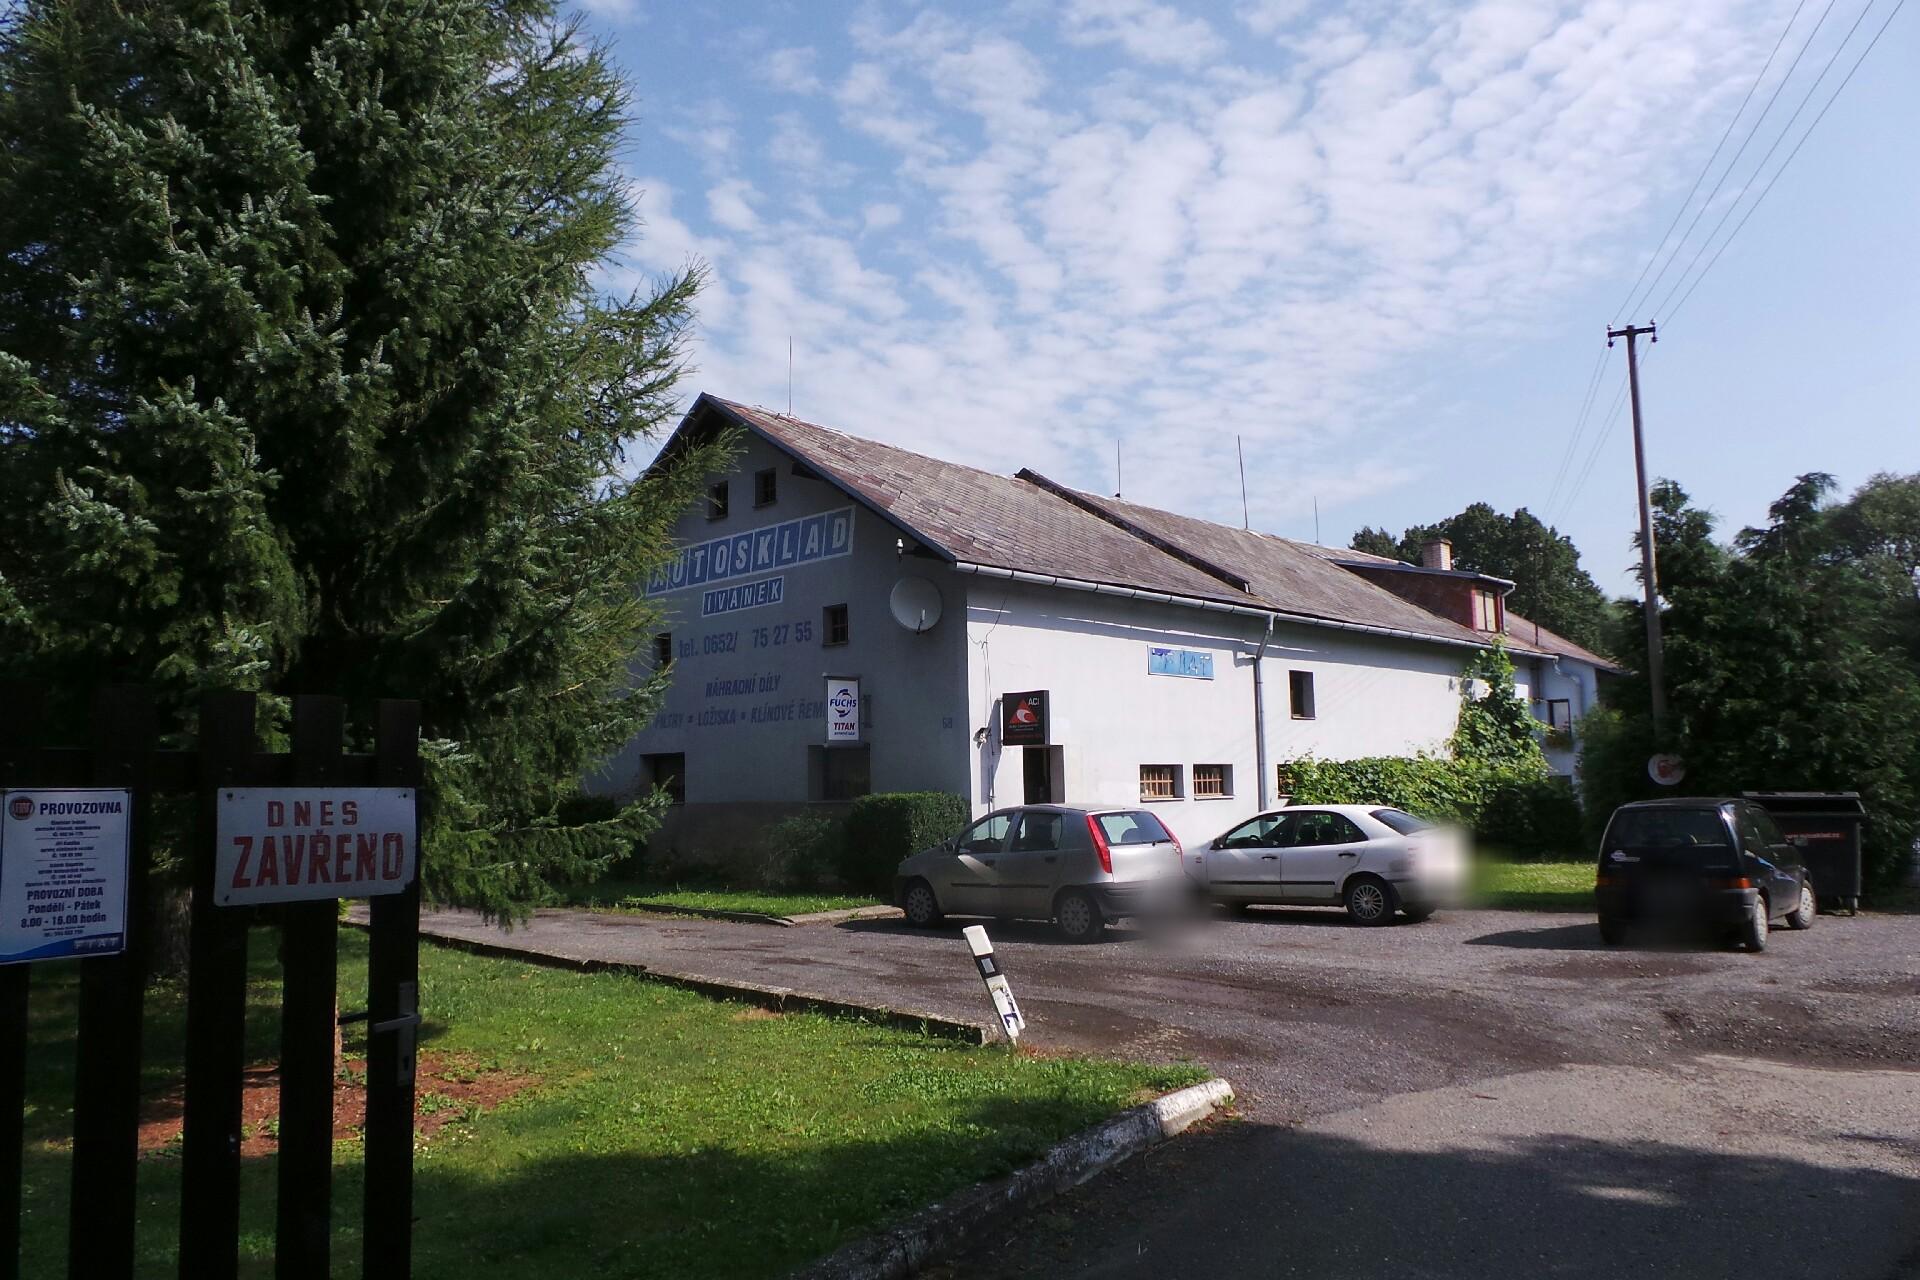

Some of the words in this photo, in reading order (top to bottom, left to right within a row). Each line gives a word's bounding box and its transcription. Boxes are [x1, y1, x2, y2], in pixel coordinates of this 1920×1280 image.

[706, 579, 782, 612] IVANEK
[679, 638, 699, 659] tel.
[752, 627, 769, 649] 75
[773, 624, 790, 645] 27
[795, 621, 813, 642] 55
[705, 672, 757, 698] NÁHRADNÍ
[758, 672, 782, 694] DÍLY
[829, 698, 857, 708] FUCHS
[698, 706, 736, 727] LOŽISKA
[750, 701, 795, 724] KLÍNOVÉ
[833, 722, 856, 731] TITAN
[40, 802, 122, 815] PROVOZOVNA
[267, 800, 360, 827] DNES
[232, 830, 404, 888] ZAVŘENO
[27, 887, 75, 901] PROVOZNÍ
[78, 886, 103, 898] DOBA
[28, 902, 65, 914] Pondělí
[74, 900, 101, 912] Pátek
[80, 913, 106, 924] hodin
